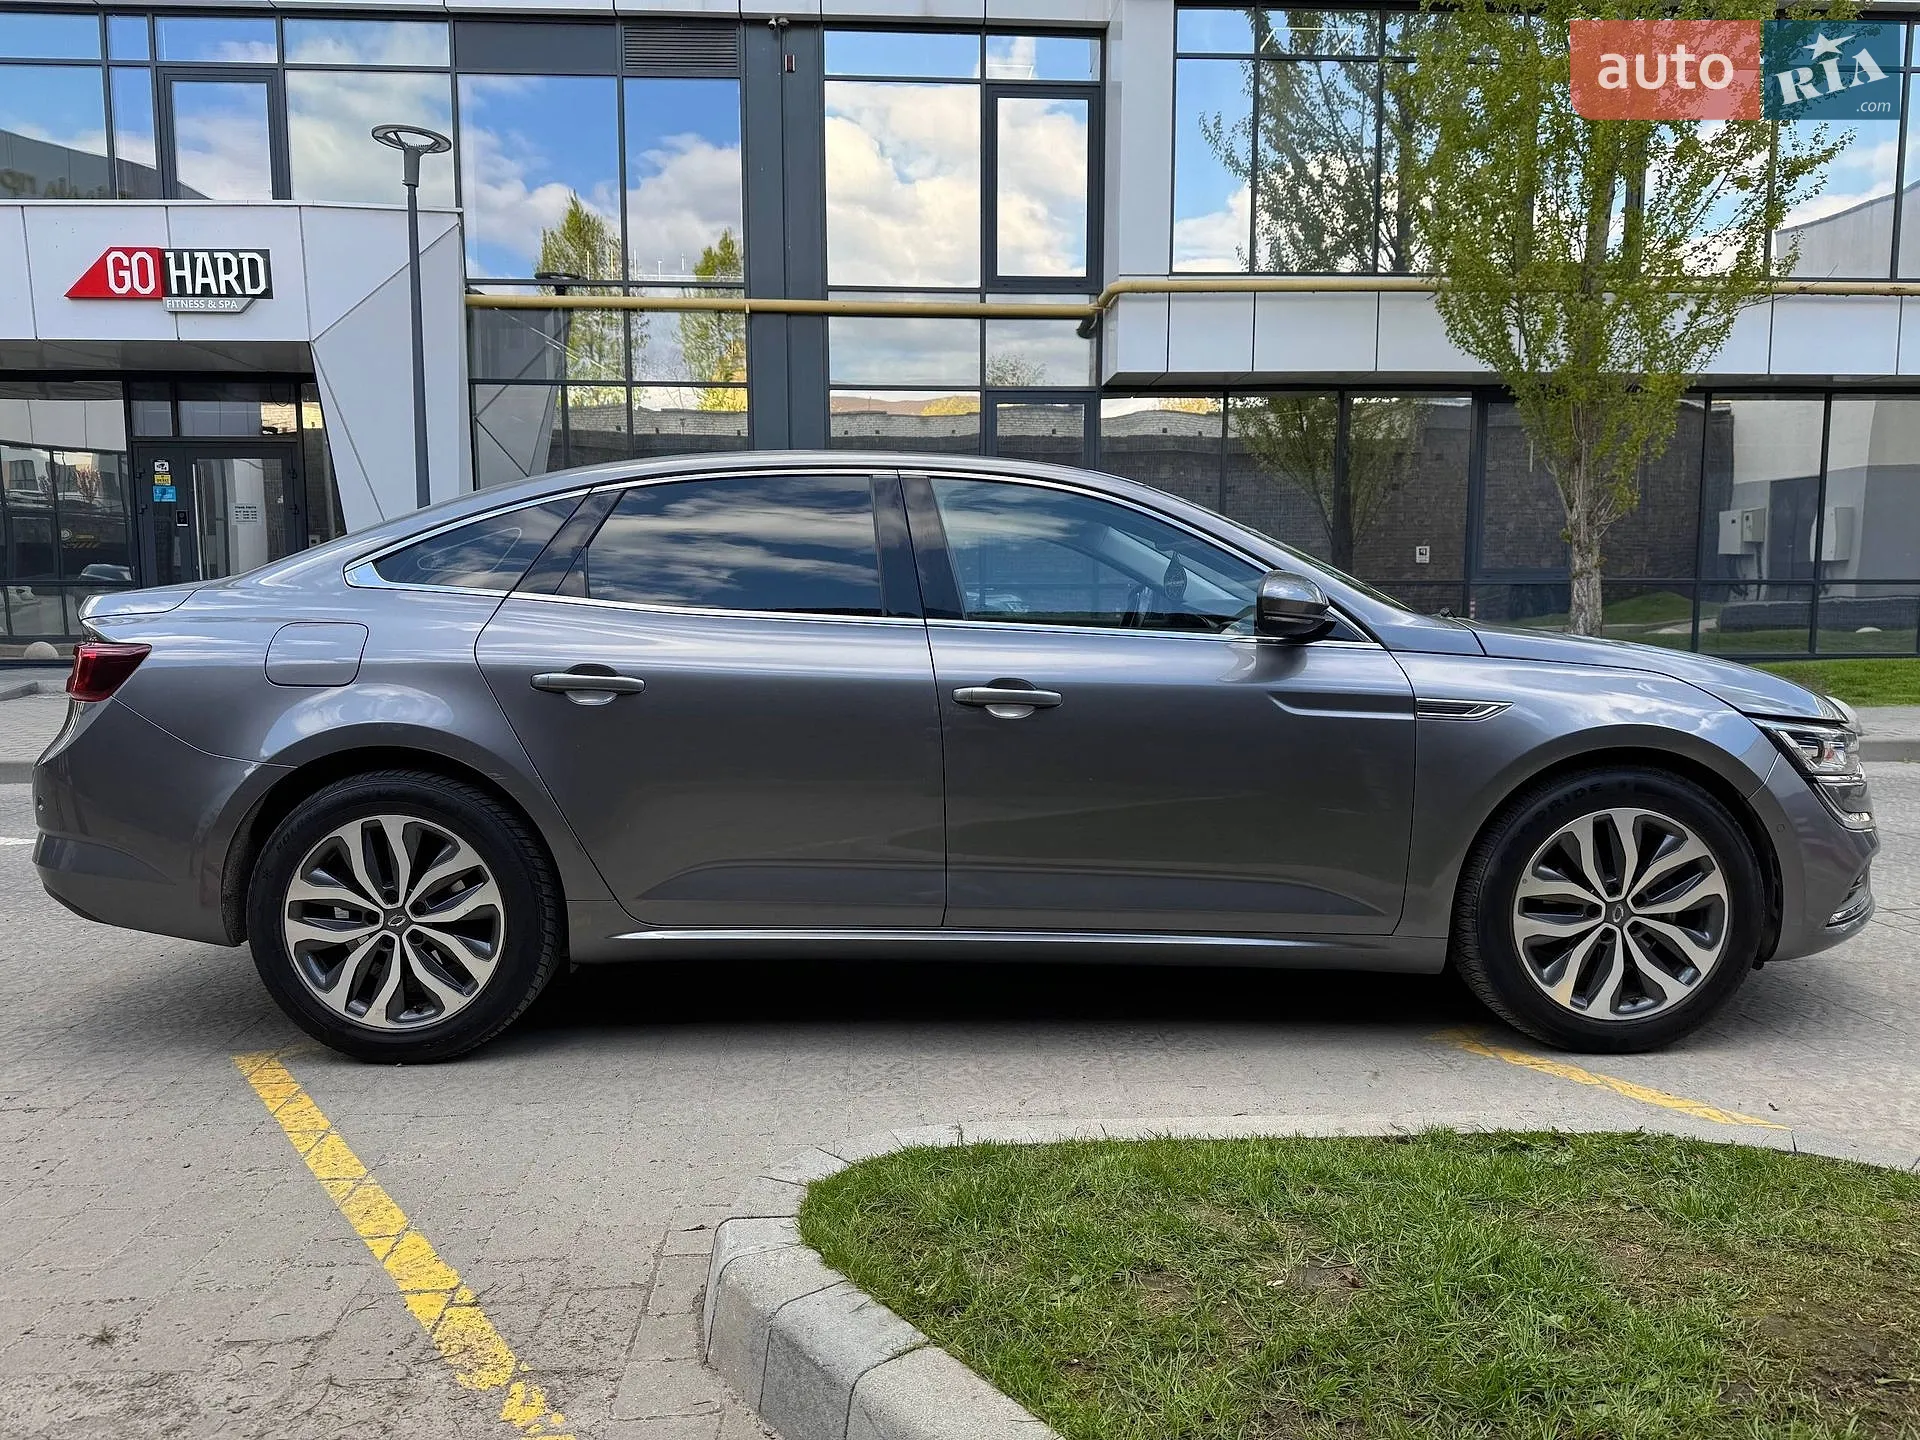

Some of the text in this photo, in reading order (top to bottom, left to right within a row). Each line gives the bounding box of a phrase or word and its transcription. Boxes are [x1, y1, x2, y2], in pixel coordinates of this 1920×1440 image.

[106, 251, 267, 295] GO HARD
[166, 299, 238, 310] FITNESS & SPA
